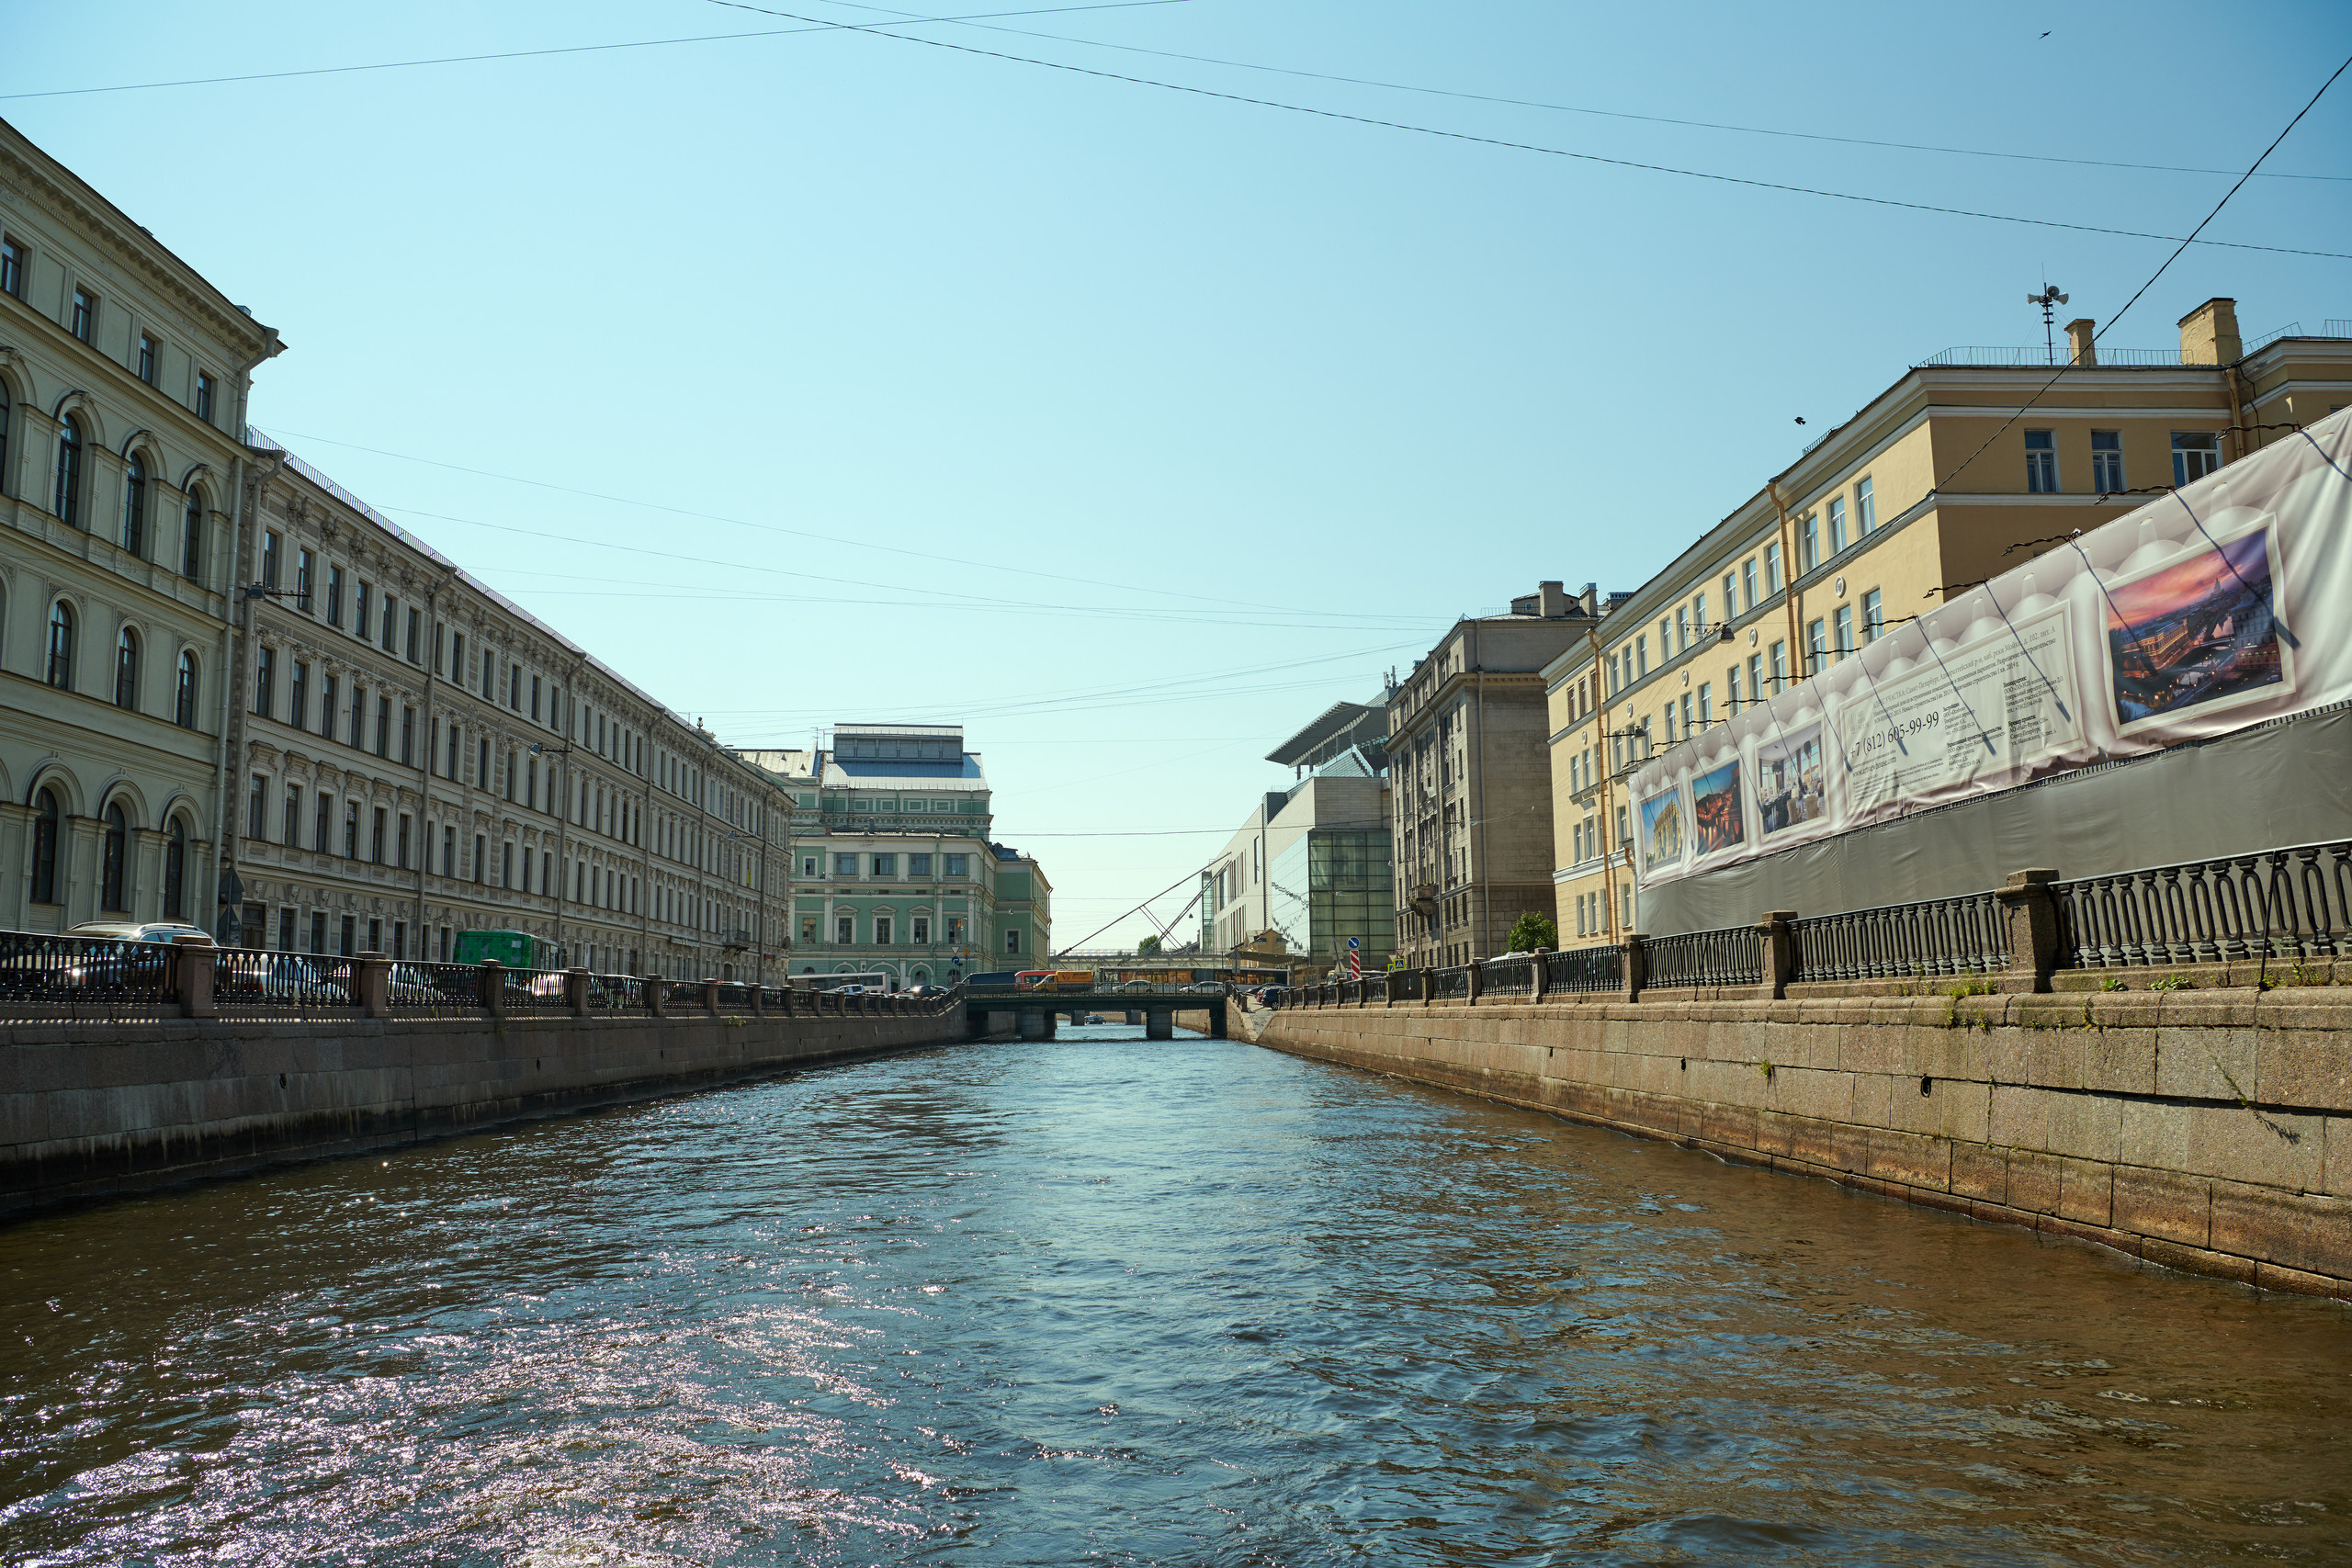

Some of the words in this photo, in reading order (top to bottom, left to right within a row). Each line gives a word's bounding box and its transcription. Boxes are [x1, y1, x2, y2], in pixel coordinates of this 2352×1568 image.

[1849, 741, 1860, 759] +7
[1862, 730, 1885, 756] (812)
[1888, 712, 1939, 742] 605-99-99
